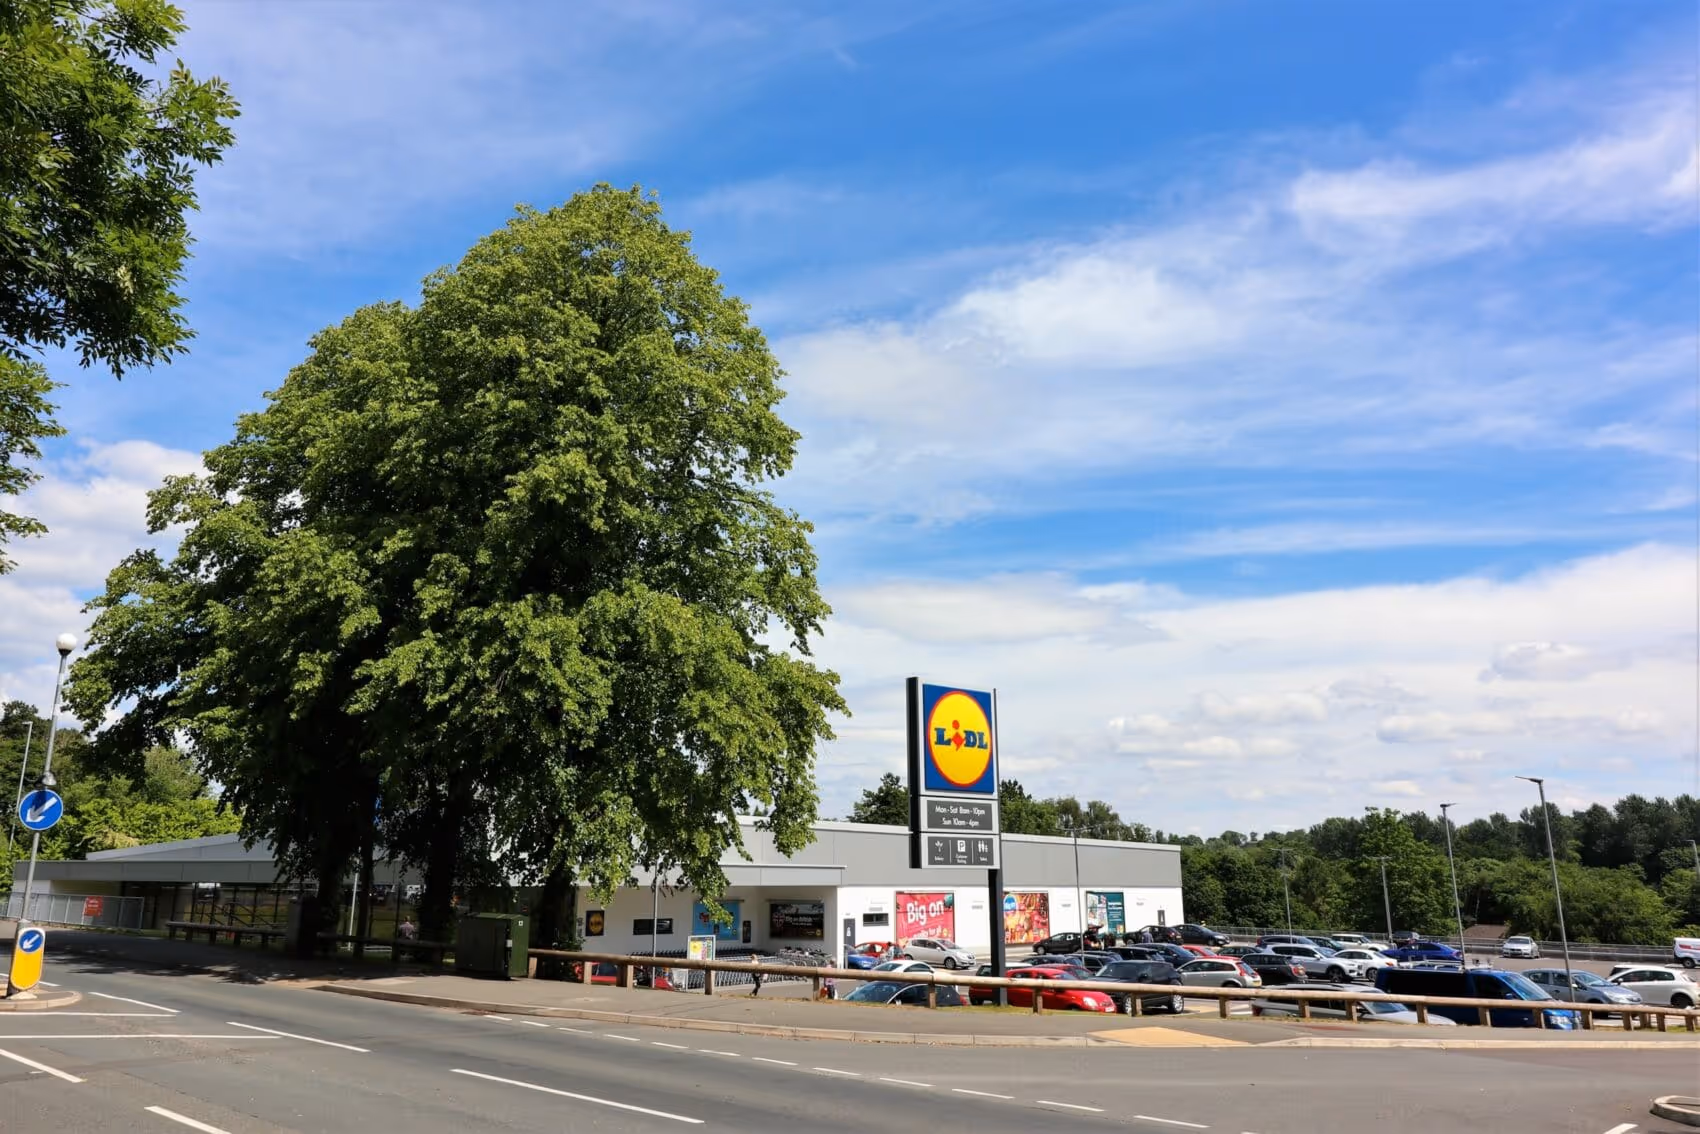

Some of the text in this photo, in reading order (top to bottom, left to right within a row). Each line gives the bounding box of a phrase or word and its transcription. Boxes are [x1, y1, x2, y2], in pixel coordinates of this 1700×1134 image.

[935, 805, 947, 813] Mon
[950, 805, 958, 814] Sat
[973, 807, 985, 817] 10pm
[942, 817, 952, 825] Sun
[906, 900, 944, 927] Big on
